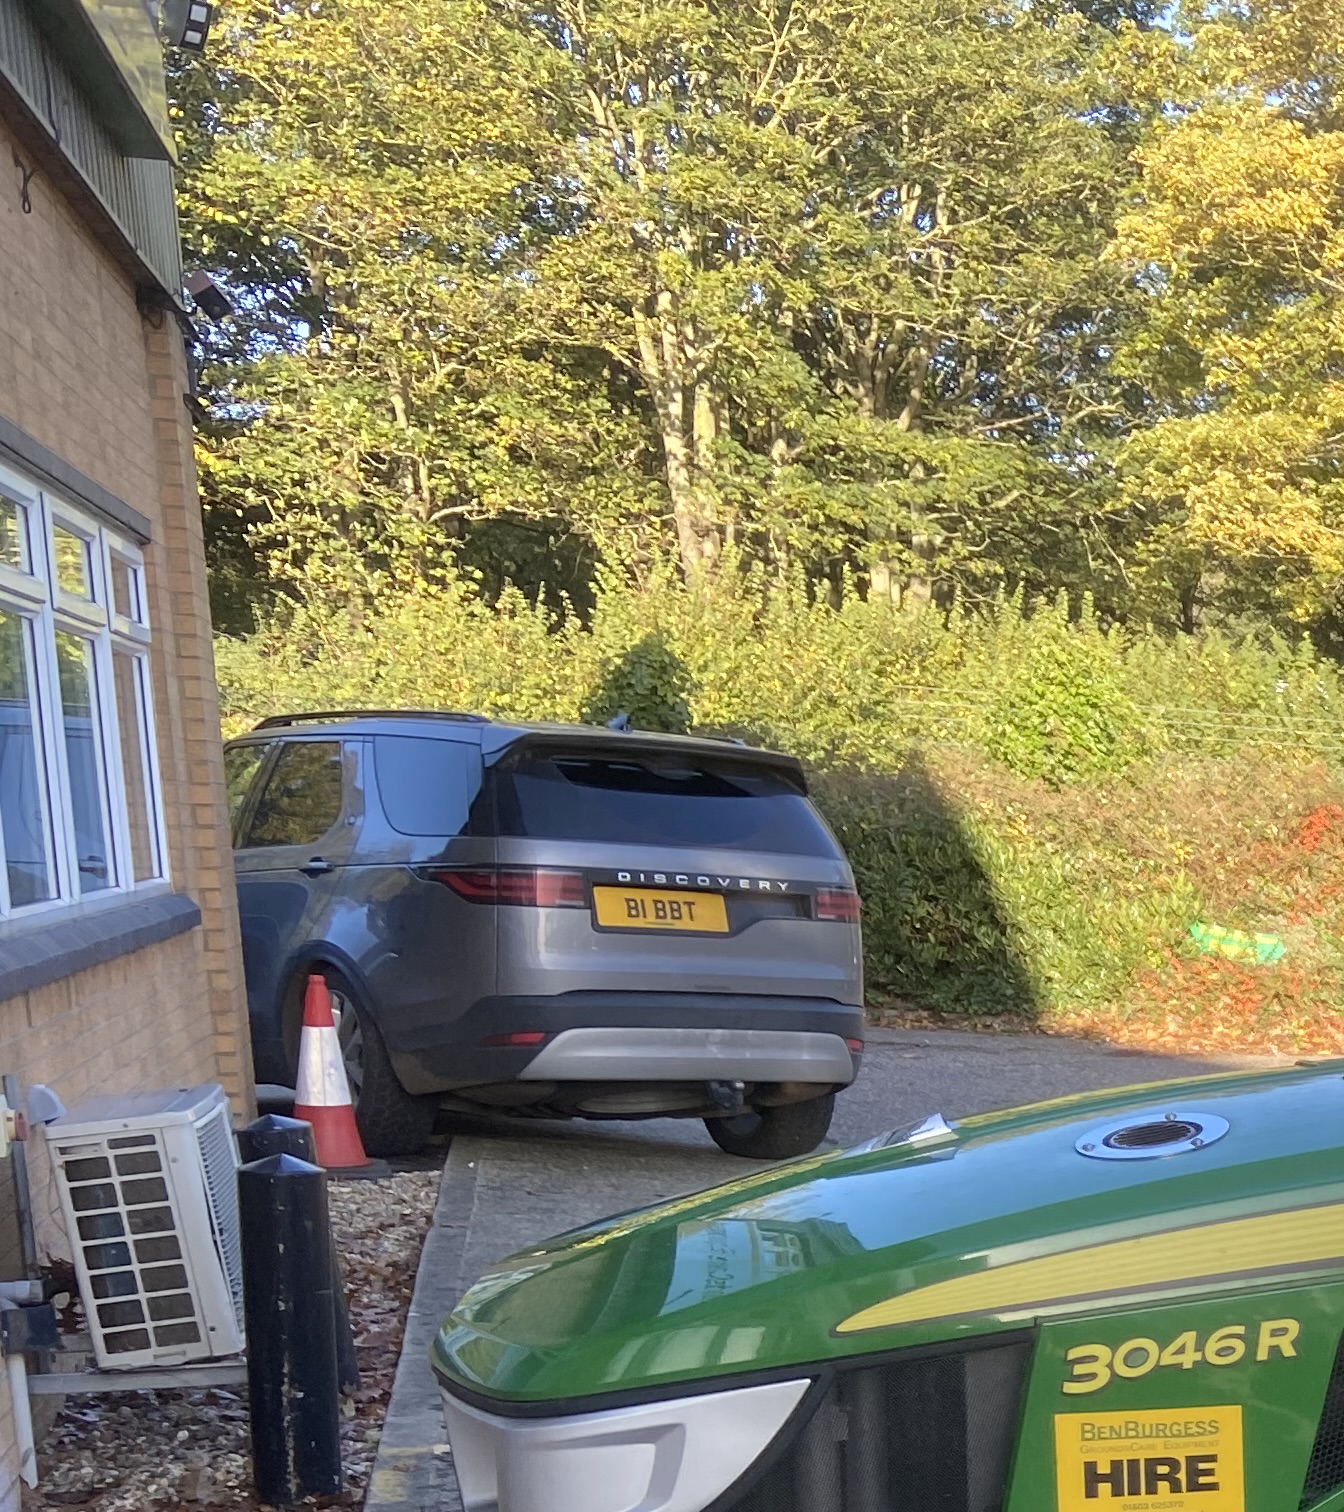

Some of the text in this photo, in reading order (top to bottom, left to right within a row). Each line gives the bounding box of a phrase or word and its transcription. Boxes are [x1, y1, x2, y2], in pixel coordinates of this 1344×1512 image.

[617, 871, 789, 892] DISCOVERY
[653, 899, 696, 922] BBT
[1084, 1454, 1220, 1499] HIRE
